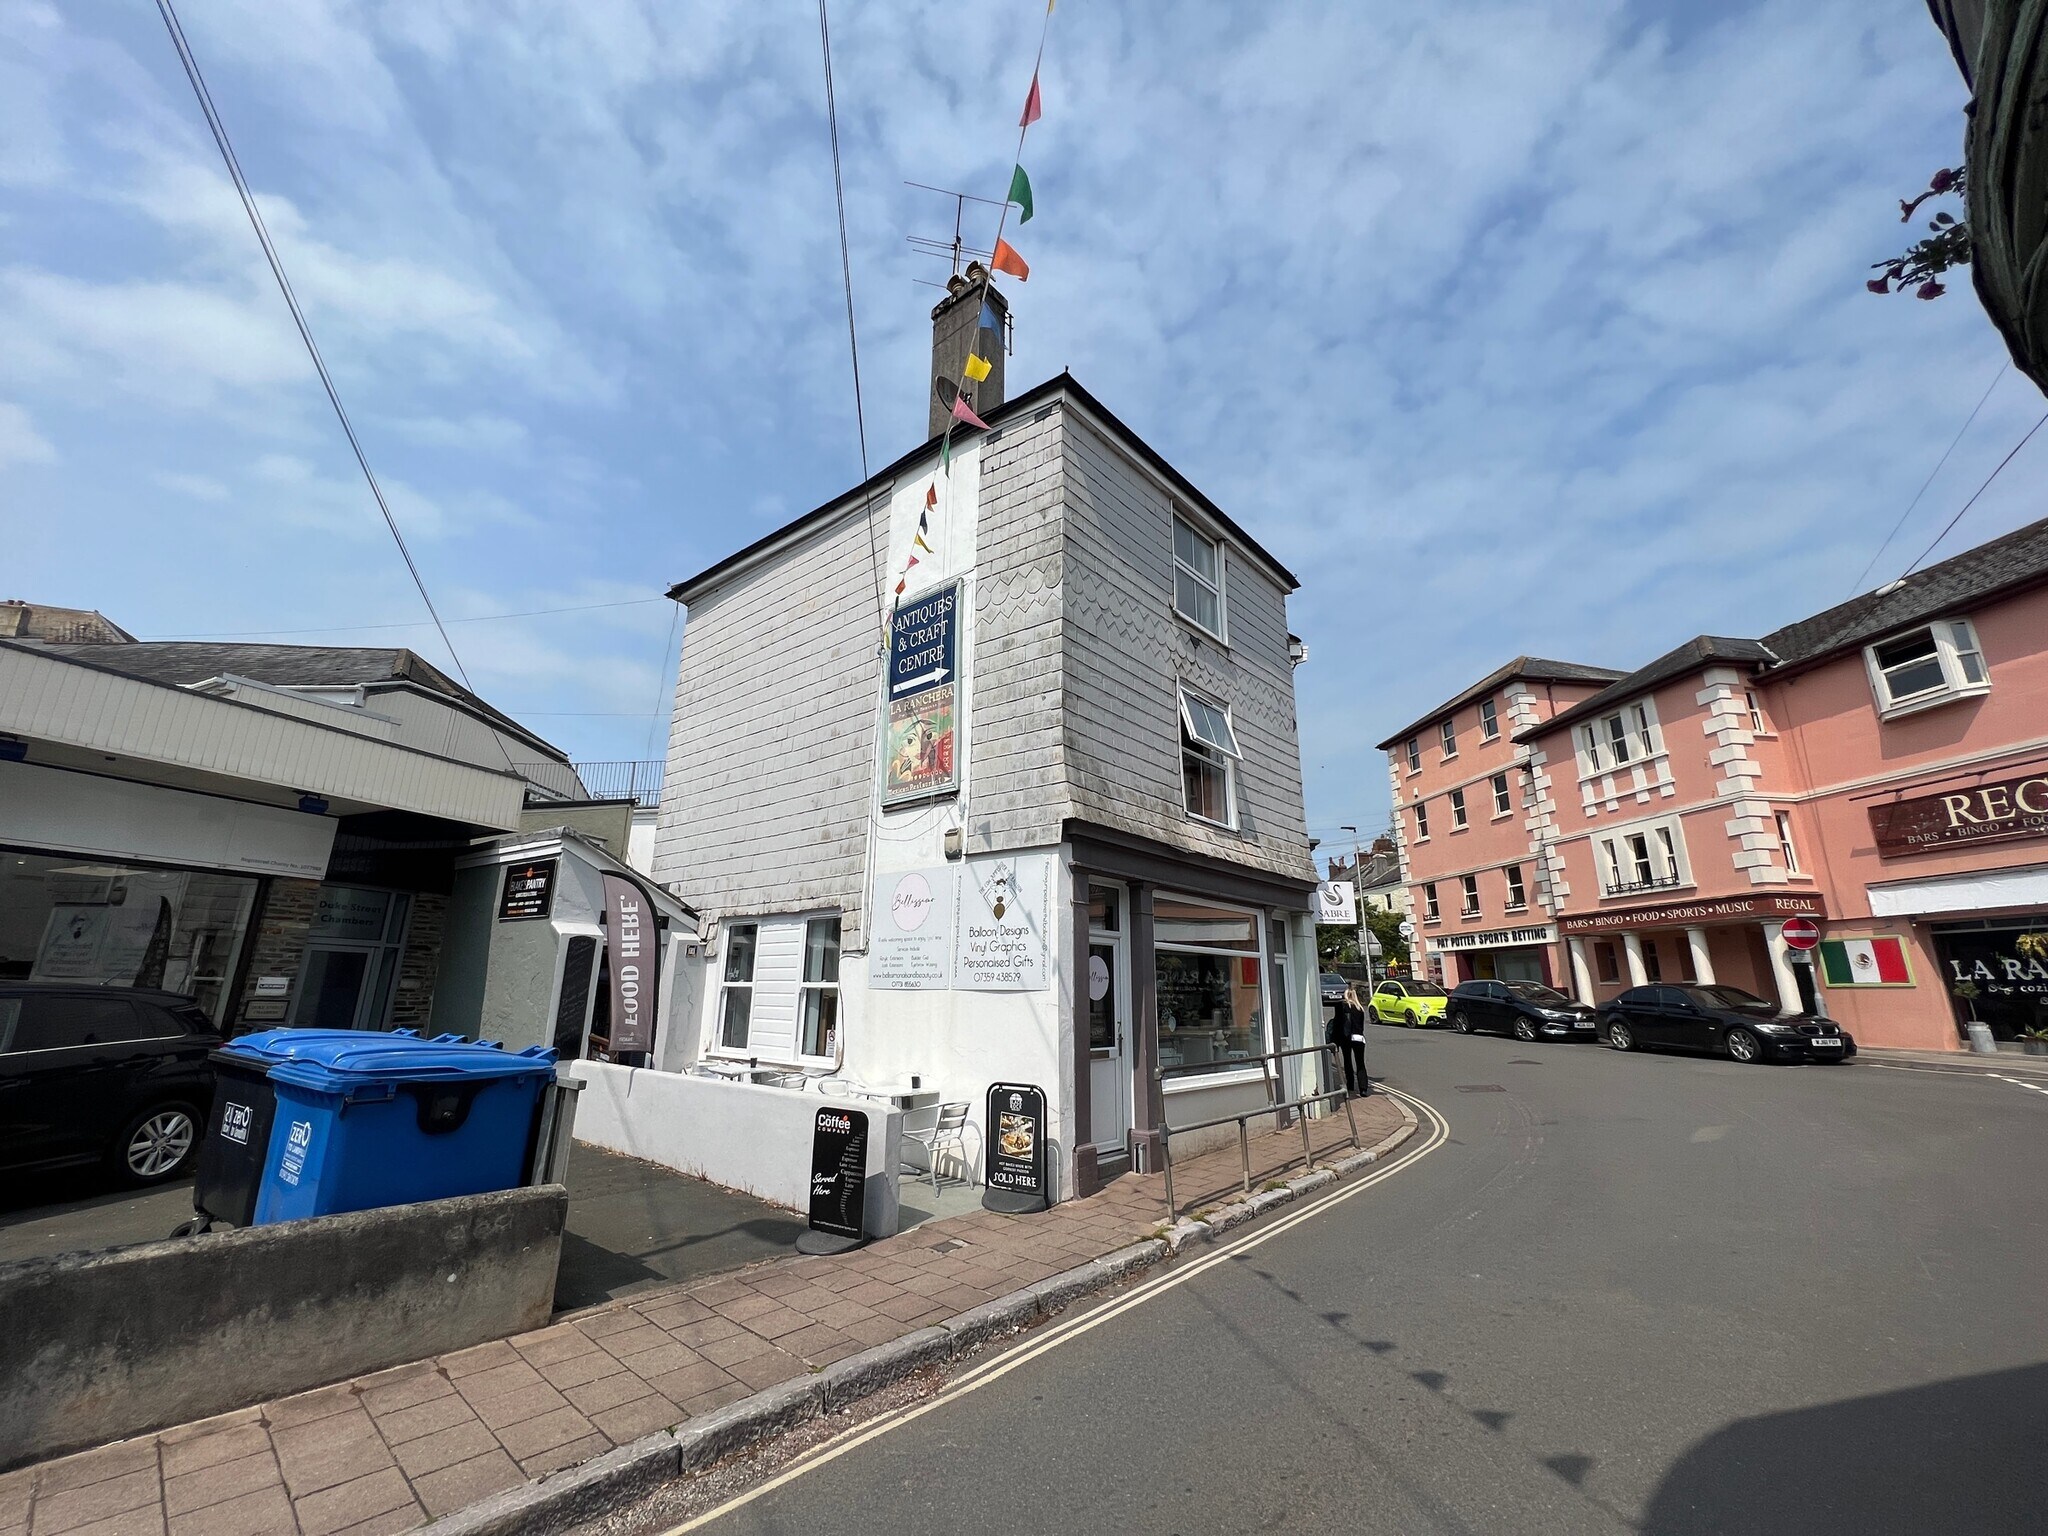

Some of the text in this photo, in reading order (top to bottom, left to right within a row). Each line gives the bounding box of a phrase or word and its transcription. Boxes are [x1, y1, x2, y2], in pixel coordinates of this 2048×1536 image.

[895, 595, 953, 632] ANTIQUES
[898, 620, 948, 652] & CRAFT
[898, 644, 945, 674] CENTRE
[890, 702, 901, 716] LA
[904, 686, 954, 711] RANCHERA
[1940, 777, 2048, 828] REG
[1907, 831, 1940, 844] BARS
[1957, 823, 2000, 837] BINGO
[319, 900, 382, 914] Duke Street
[1318, 909, 1351, 919] SABRE
[1566, 898, 1815, 929] BARS BINGO FOOD SPORTS MUSIC REGAL
[320, 914, 374, 926] Chambers
[969, 924, 1029, 939] Balloon Designs
[1437, 927, 1547, 949] PAT POTTER SPORTS BETTING
[970, 939, 1027, 956] Vinyl Graphics
[963, 955, 1034, 969] Personalised Gifts
[1949, 959, 1995, 981] LA
[974, 972, 1021, 982] 07359 438529
[817, 1126, 850, 1135] COMPANY
[818, 1114, 851, 1130] Coffee
[812, 1172, 838, 1183] Served
[993, 1171, 1037, 1188] SOLD HERE
[812, 1184, 831, 1195] Here
